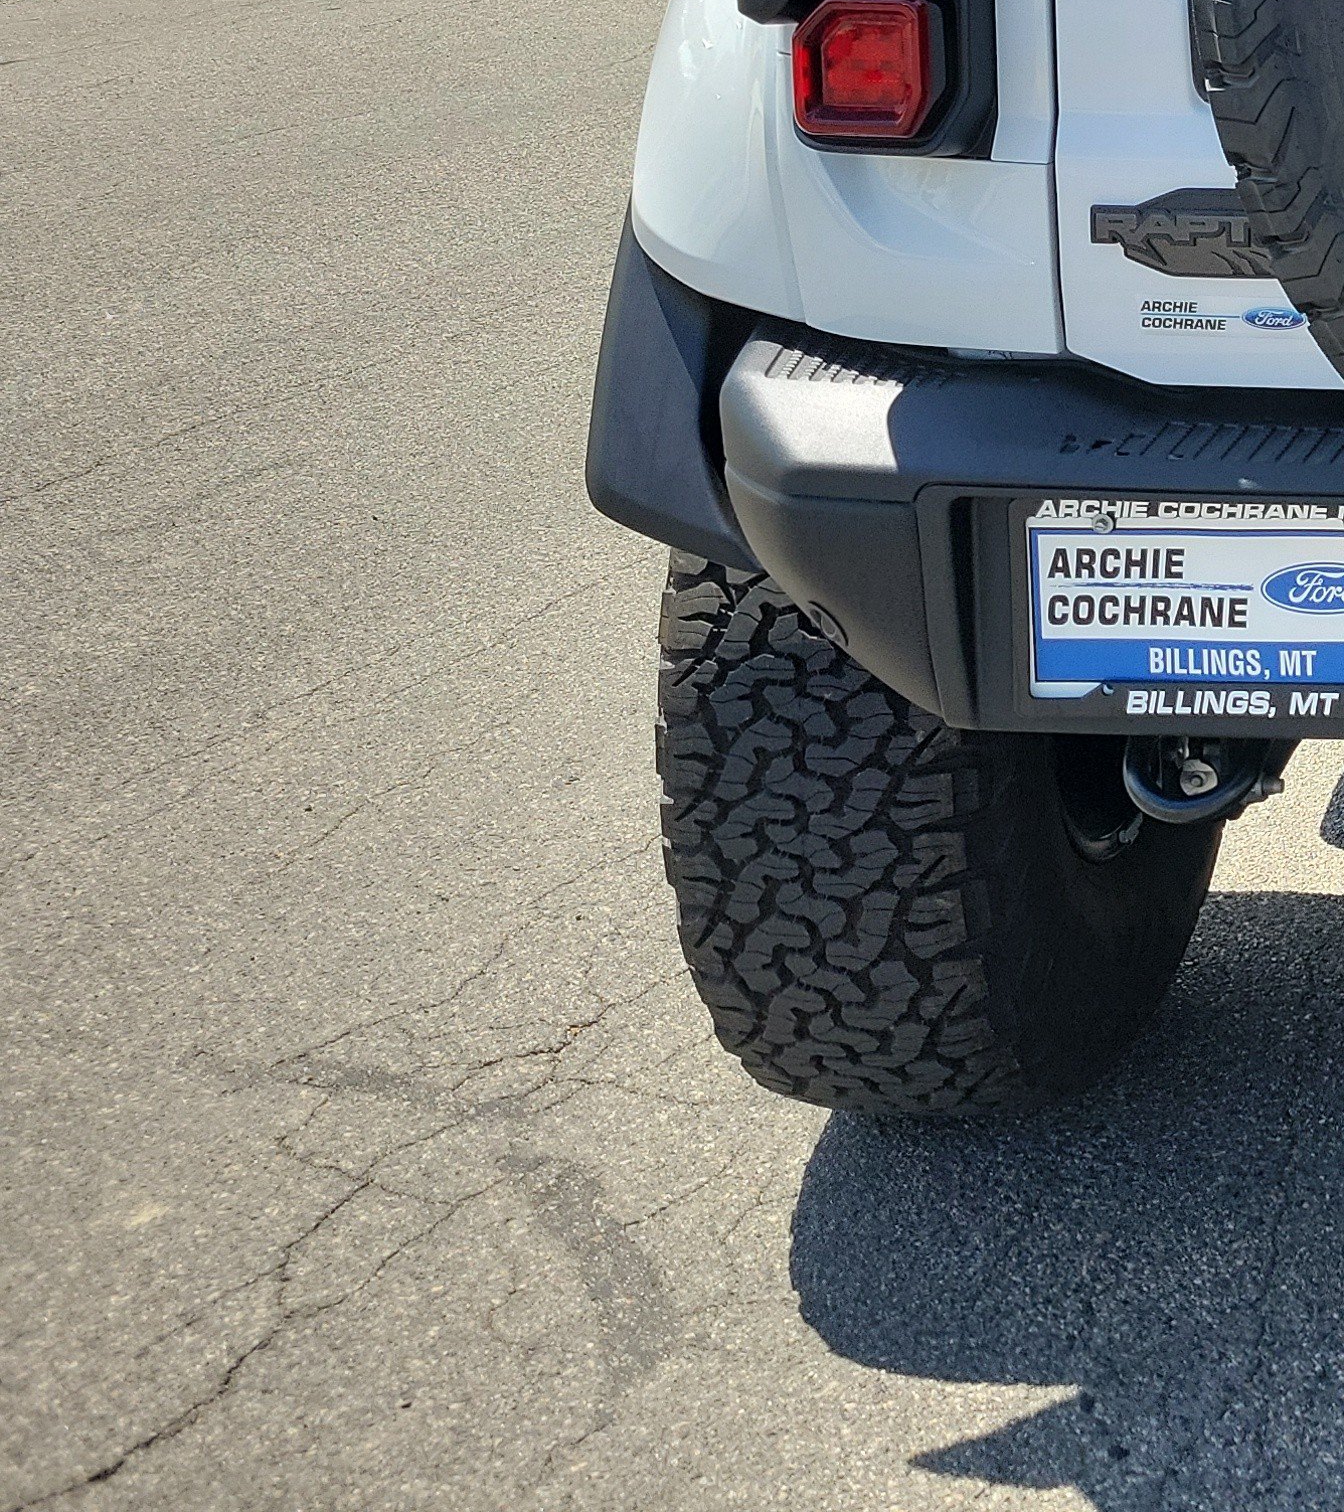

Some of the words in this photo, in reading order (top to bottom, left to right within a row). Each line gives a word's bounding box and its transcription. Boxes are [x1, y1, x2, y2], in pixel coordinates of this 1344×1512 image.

[1094, 212, 1251, 246] RAPT
[1140, 300, 1198, 314] ARCHIE
[1253, 310, 1294, 328] Ford
[1141, 317, 1228, 331] COCHRANE
[1035, 499, 1150, 519] ARCHIE
[1157, 501, 1328, 520] COCHRANE
[1047, 547, 1187, 580] ARCHIE
[1047, 594, 1249, 629] COCHRANE
[1148, 647, 1271, 680] BILLINGS,
[1279, 649, 1318, 677] MT
[1125, 689, 1278, 719] BILLINGS,
[1287, 691, 1340, 717] MT
